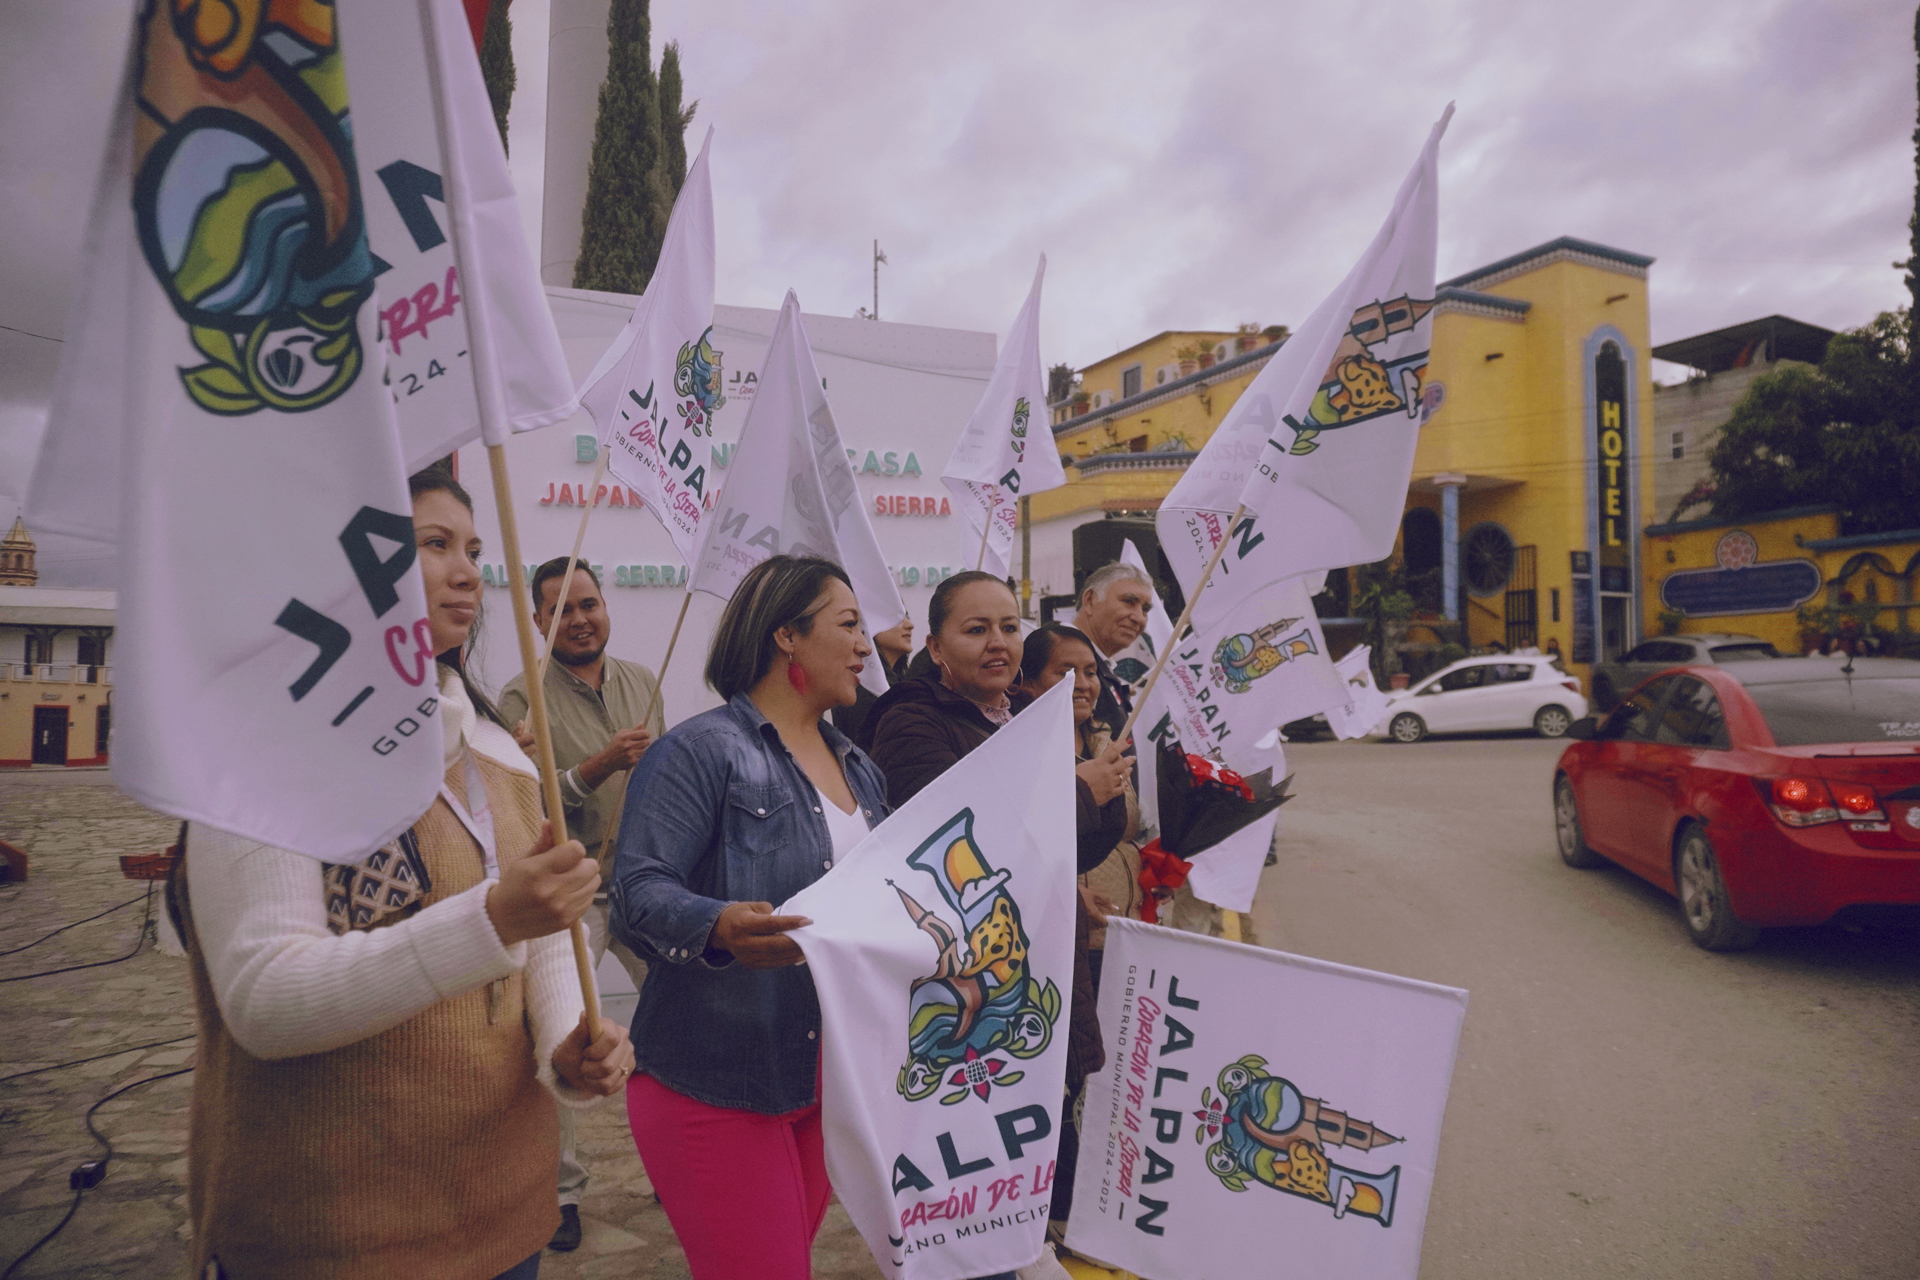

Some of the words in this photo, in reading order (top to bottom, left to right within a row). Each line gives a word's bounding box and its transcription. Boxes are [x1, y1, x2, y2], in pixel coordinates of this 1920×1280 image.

[875, 495, 951, 516] SIERRA
[1603, 400, 1622, 547] HOTEL
[1118, 965, 1137, 1046] GOBIERNO
[1129, 996, 1161, 1081] CORAZÓN
[1110, 1052, 1124, 1127] MUNICIPAL
[1122, 1106, 1142, 1133] LA
[1126, 1078, 1144, 1111] DE
[1135, 975, 1199, 1237] JALPAN
[986, 1174, 1025, 1213] DE
[1116, 1130, 1141, 1198] SIERRA
[955, 1203, 1050, 1239] MUNICIP
